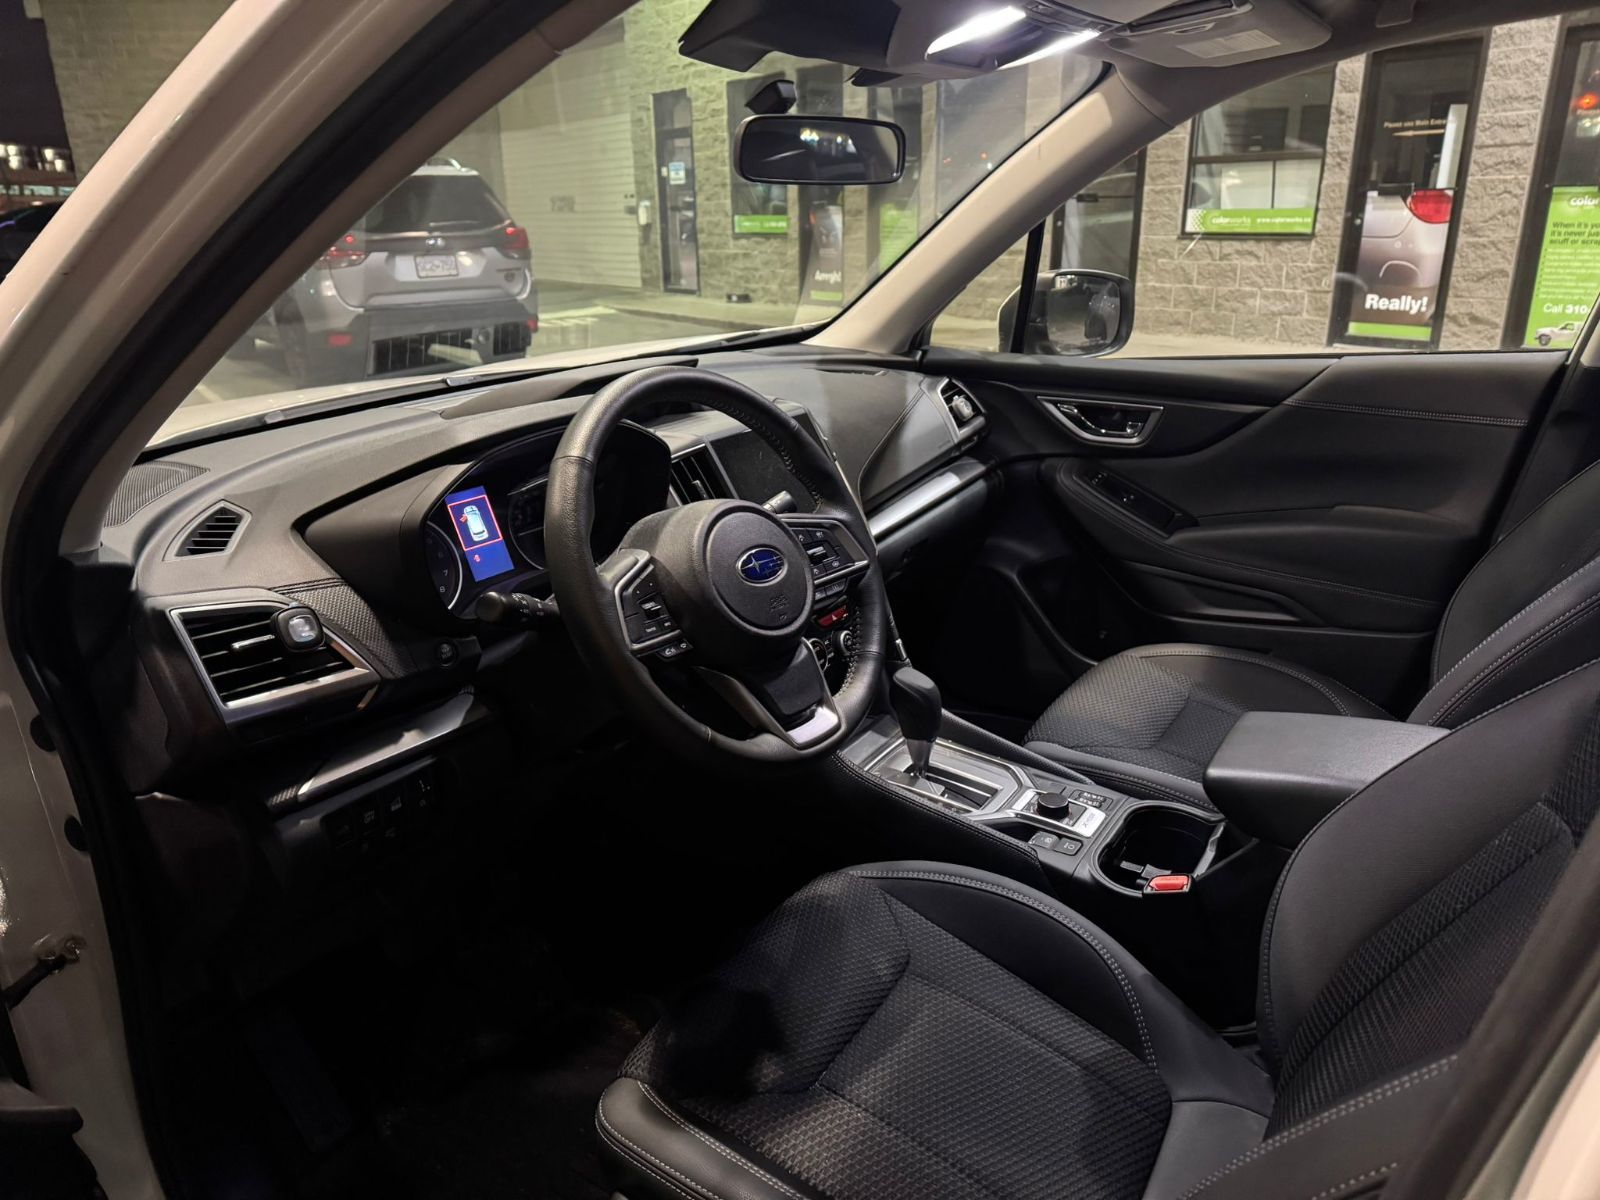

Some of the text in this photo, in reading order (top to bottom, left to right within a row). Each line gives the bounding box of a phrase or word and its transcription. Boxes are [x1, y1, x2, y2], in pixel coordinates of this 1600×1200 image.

[1552, 221, 1575, 229] When
[1576, 221, 1589, 229] it's
[1364, 293, 1429, 315] Really!
[1543, 302, 1563, 313] Call
